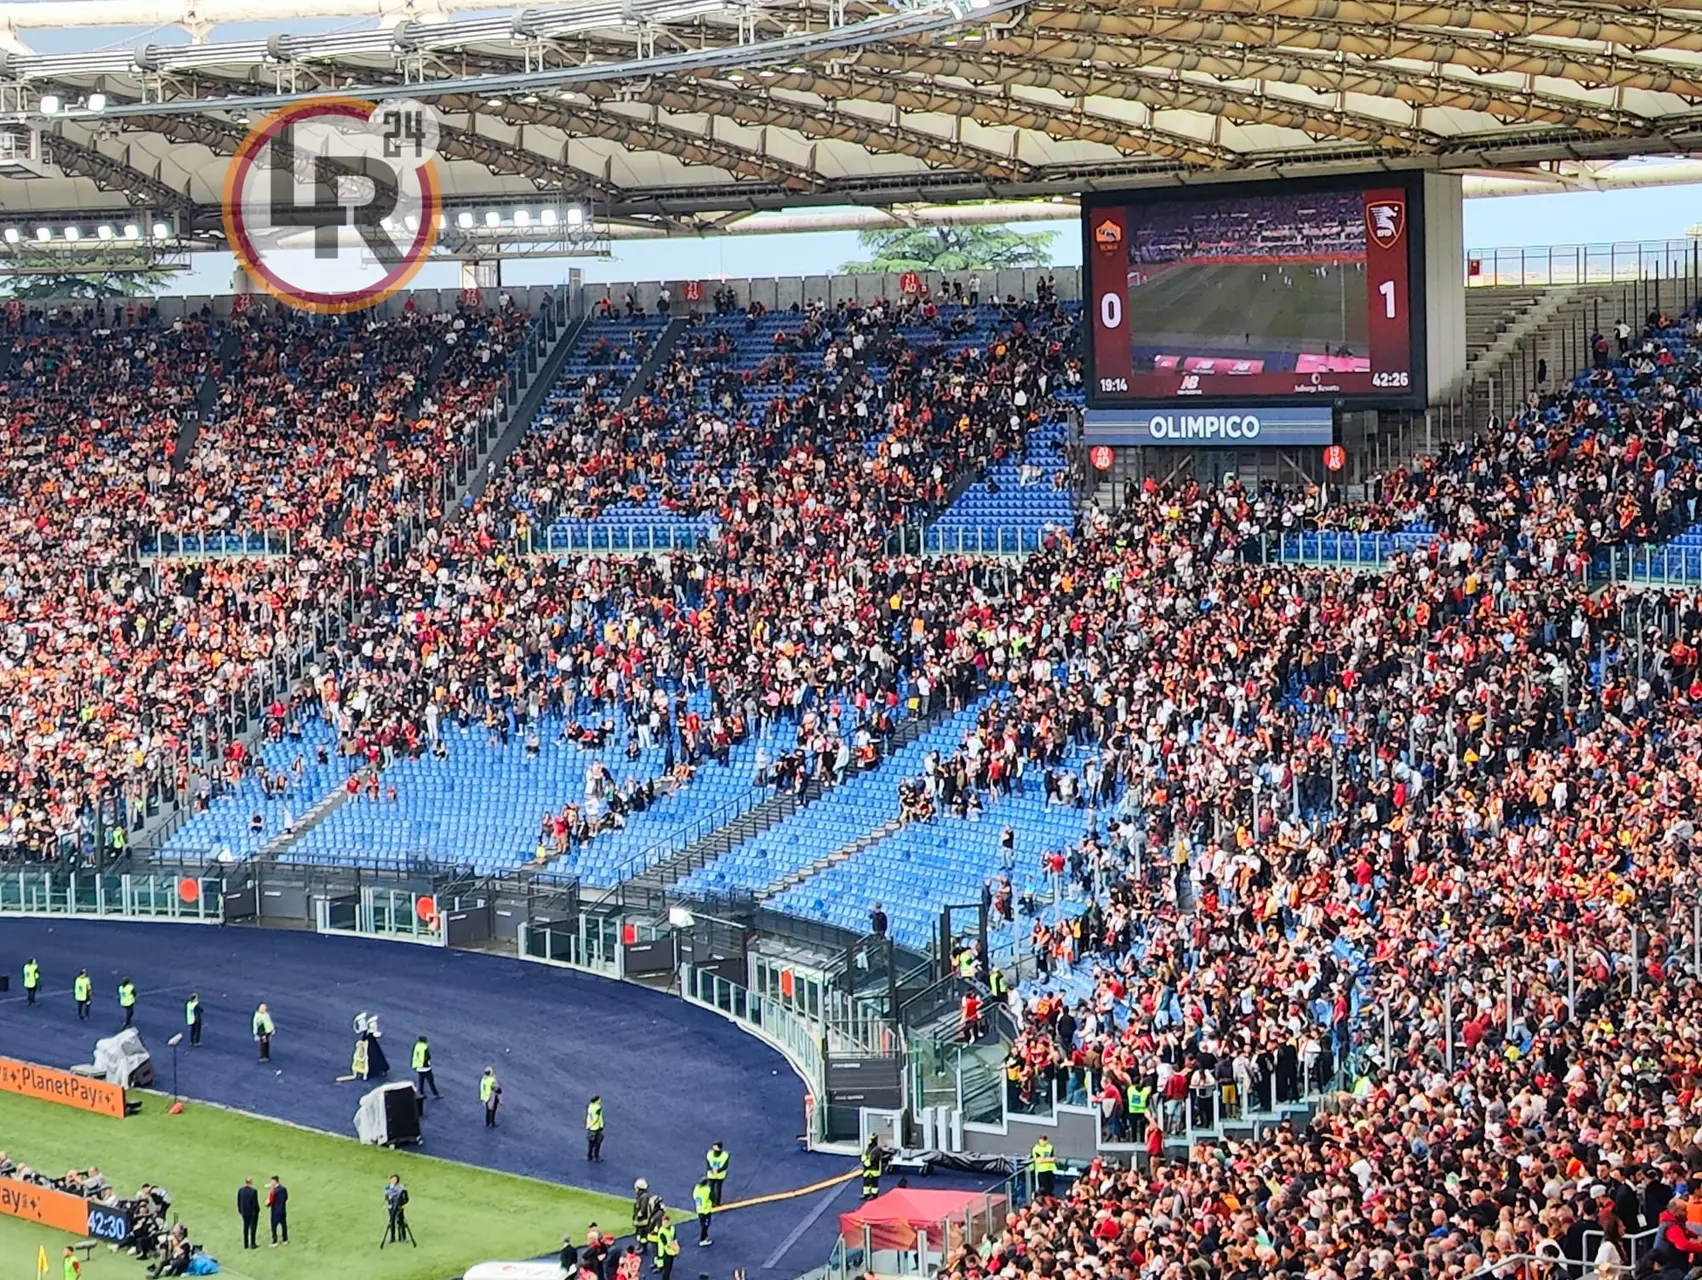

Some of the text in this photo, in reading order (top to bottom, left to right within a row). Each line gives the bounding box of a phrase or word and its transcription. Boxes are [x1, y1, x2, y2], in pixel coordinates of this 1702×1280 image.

[903, 282, 917, 293] AD
[1379, 280, 1396, 319] 1
[1101, 292, 1122, 328] 0
[1100, 378, 1129, 392] 19:14
[1372, 372, 1409, 387] 42:26
[1150, 415, 1260, 439] OLIMPICO
[22, 1066, 97, 1108] PlanetPay
[88, 1210, 126, 1240] 42:30
